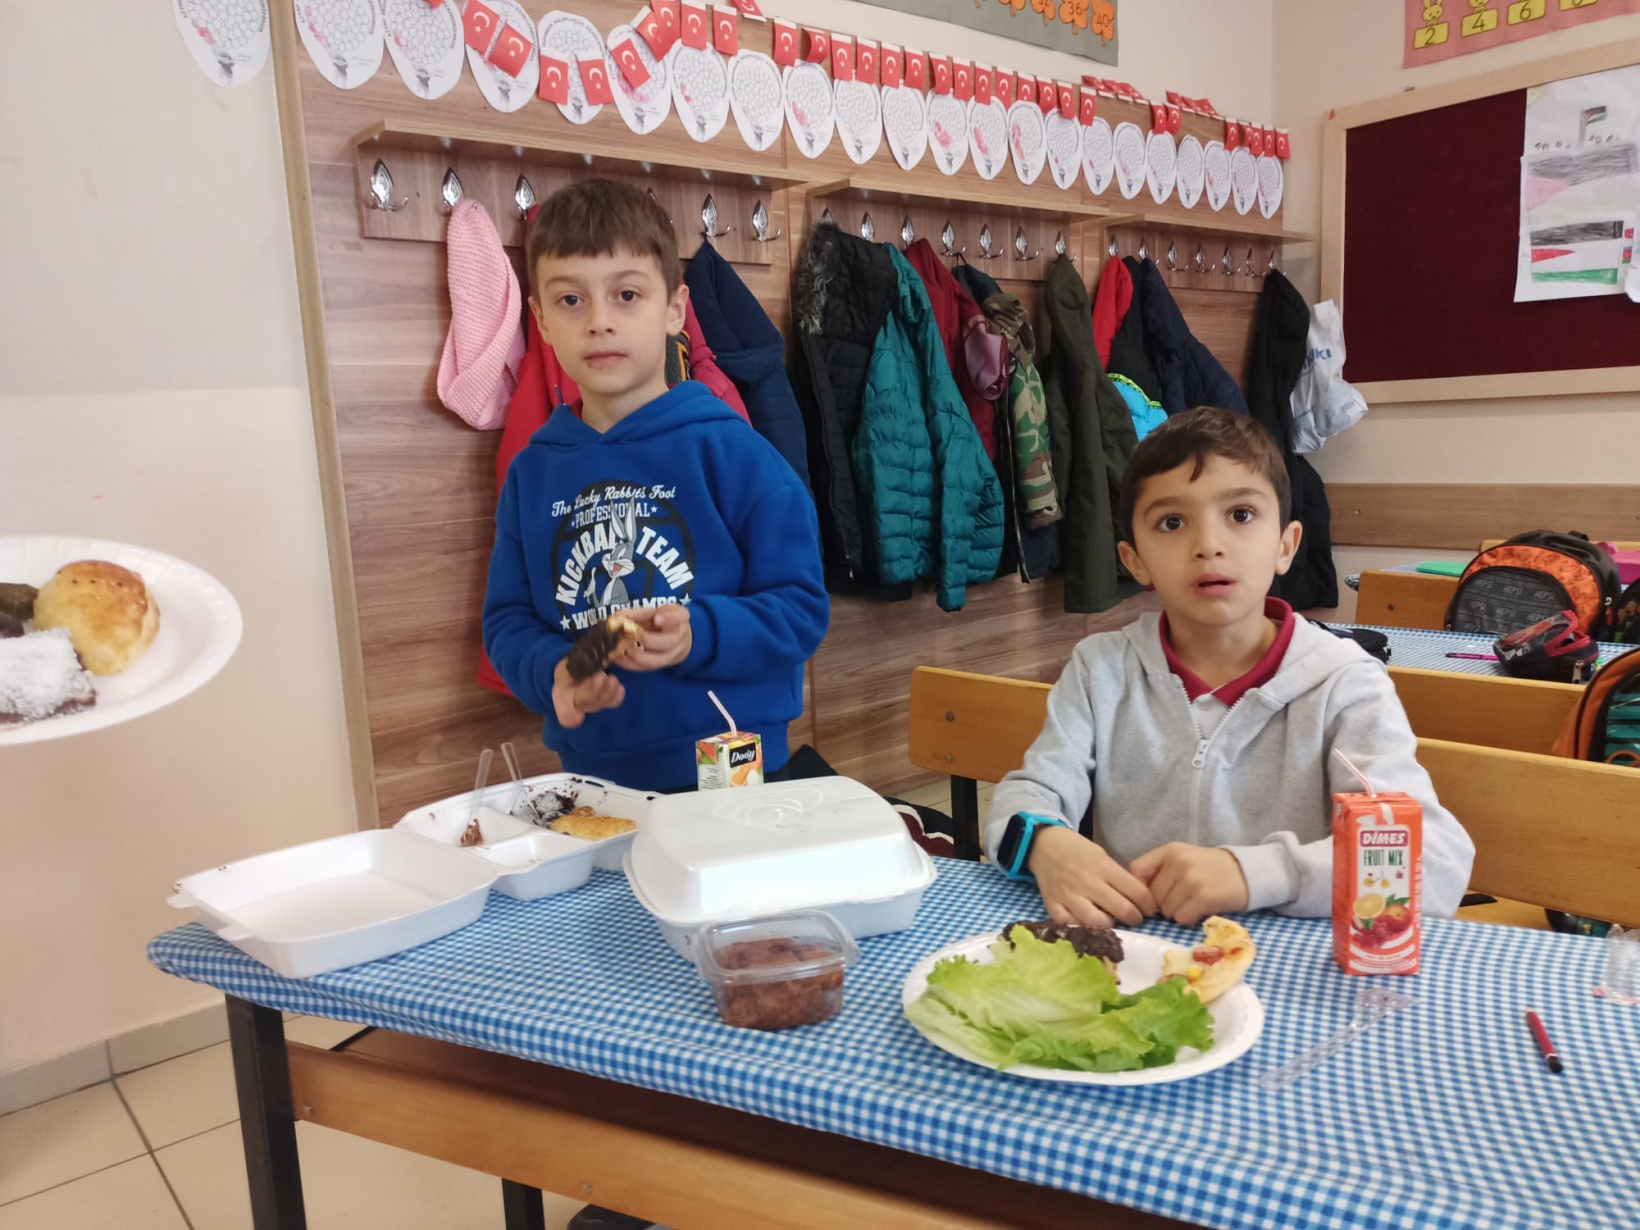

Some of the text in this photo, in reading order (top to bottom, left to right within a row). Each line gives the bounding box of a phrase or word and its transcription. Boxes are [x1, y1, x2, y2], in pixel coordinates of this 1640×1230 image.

[1068, 1, 1109, 28] 36 40
[1424, 4, 1532, 46] 2 4 6
[551, 500, 572, 517] The
[574, 489, 602, 511] Lucky
[648, 484, 676, 500] Foot
[575, 502, 651, 529] PROFESOAL
[555, 522, 695, 607] KICKBAL TEAM
[1363, 849, 1403, 867] FRUIT MIX
